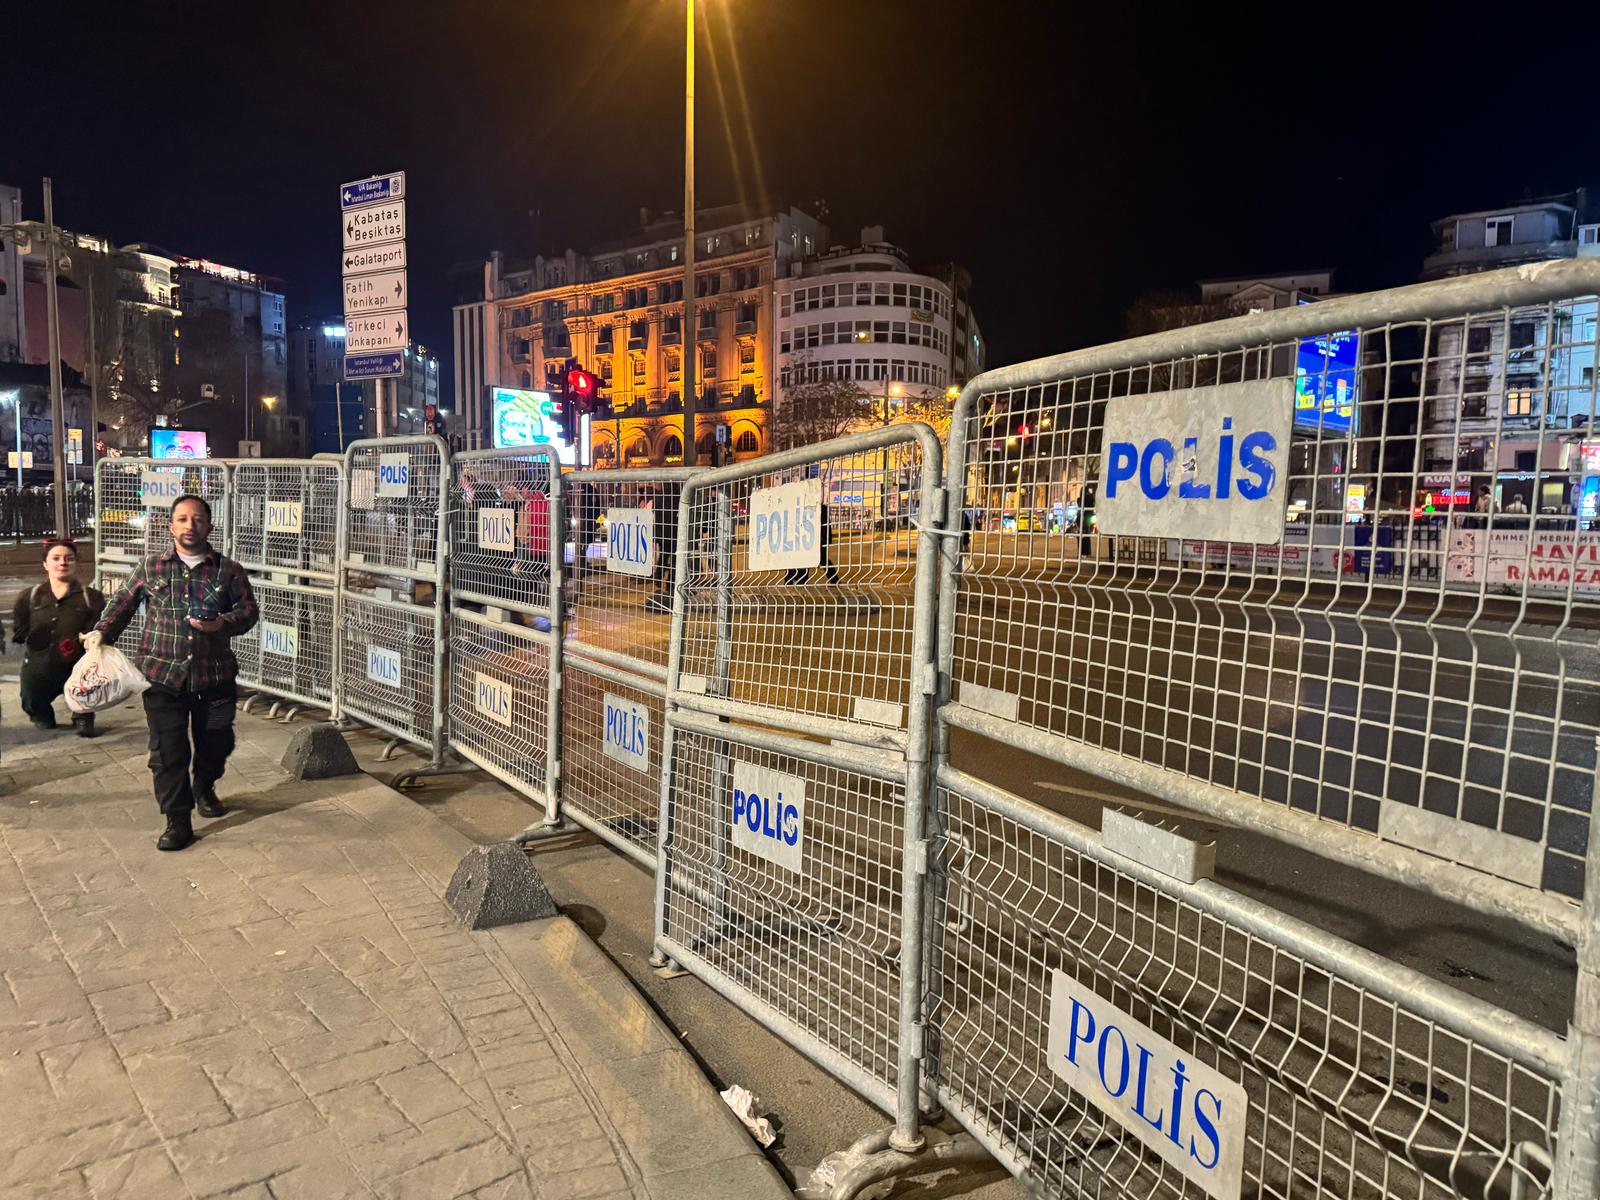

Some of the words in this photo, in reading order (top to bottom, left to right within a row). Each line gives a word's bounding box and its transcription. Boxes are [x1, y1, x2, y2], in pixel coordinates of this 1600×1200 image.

[354, 209, 399, 226] Kabataş
[355, 224, 401, 241] Beşiktaş
[354, 248, 402, 266] Galataport
[346, 280, 373, 294] Fatih
[347, 295, 388, 308] Yenikapı
[348, 336, 391, 348] Unkapanı
[1106, 416, 1277, 500] POLİS
[381, 461, 407, 484] POLİS
[269, 504, 297, 527] POLİS
[756, 496, 816, 555] POLİS
[482, 513, 511, 545] POLİS
[610, 515, 648, 565] POLİS
[266, 631, 294, 653] POLİS
[478, 681, 509, 720] POLİS
[606, 705, 644, 757] POLİS
[733, 788, 798, 846] POLİS
[1064, 995, 1222, 1169] POLİS
